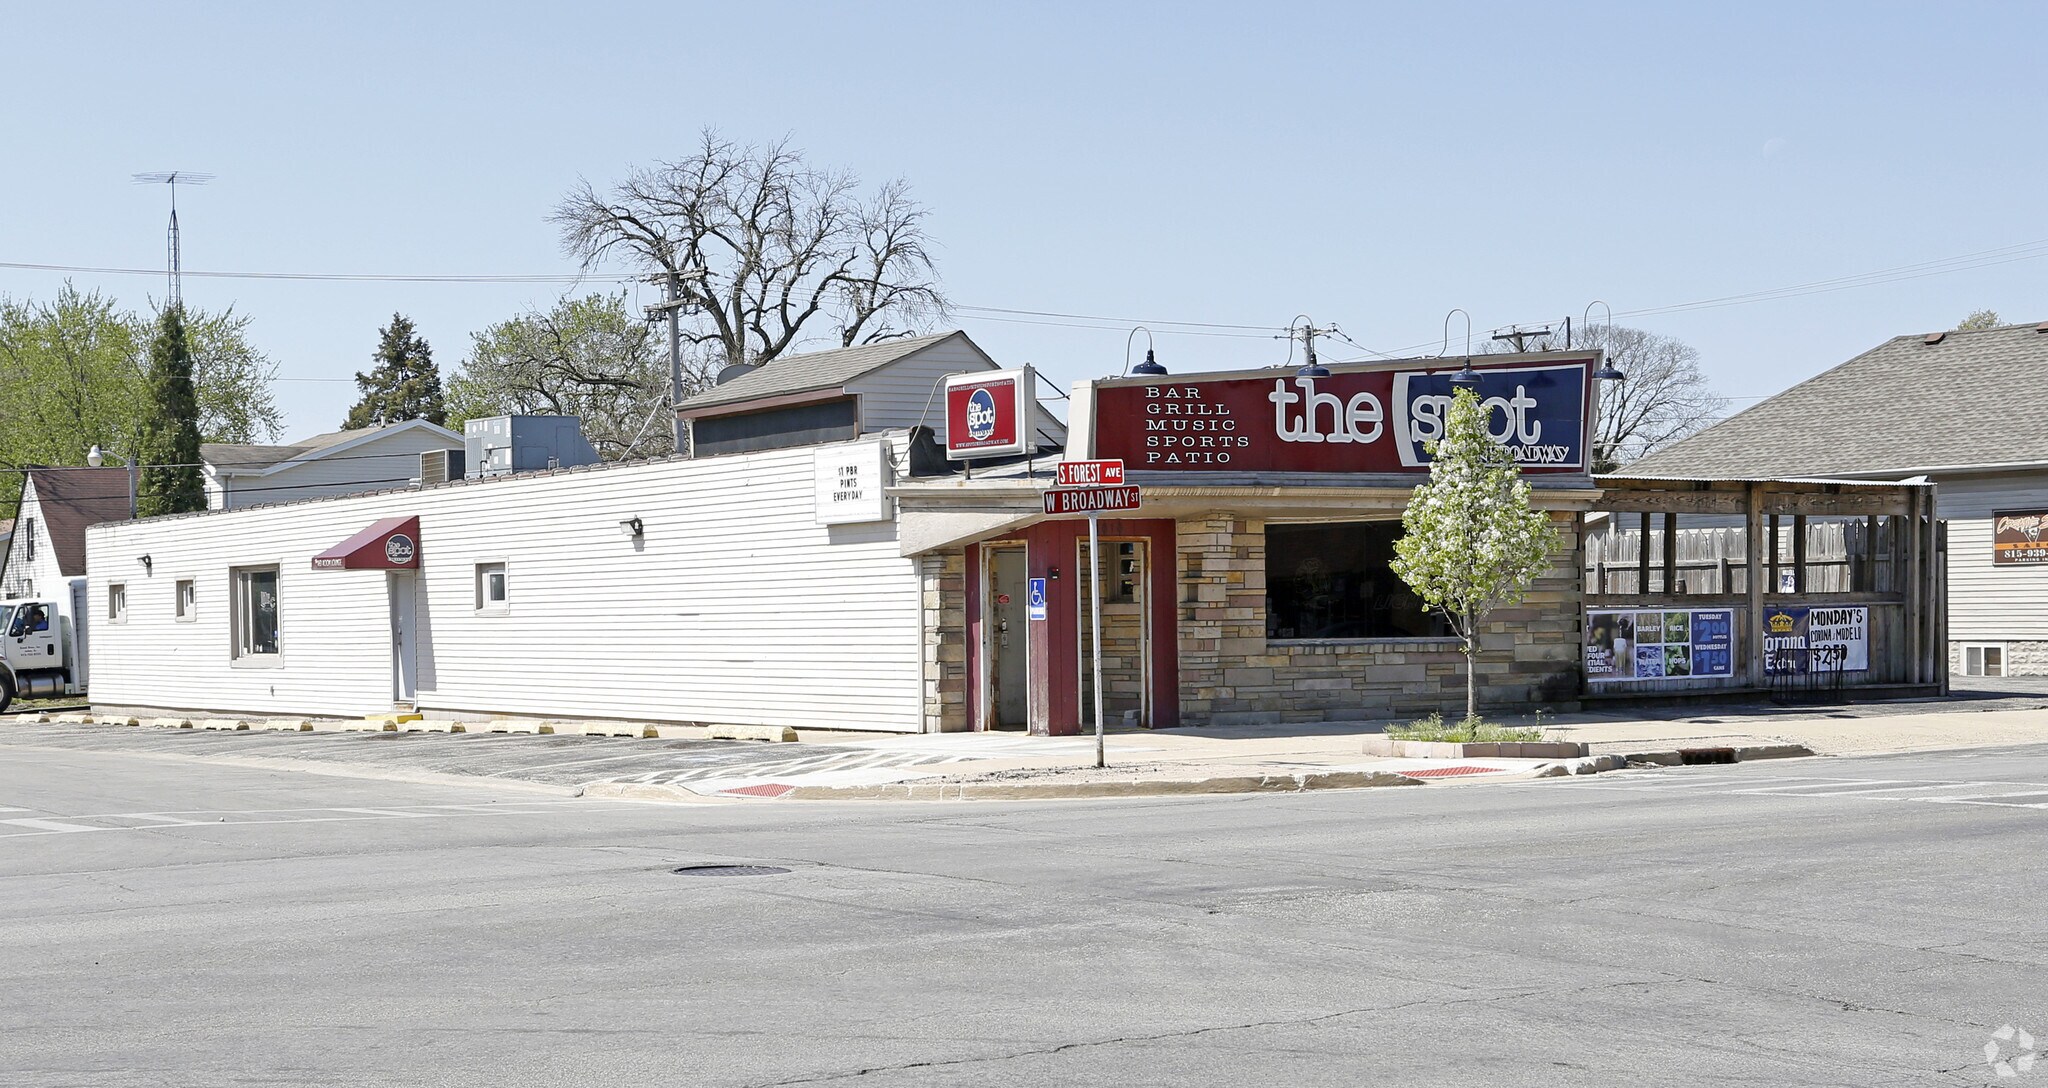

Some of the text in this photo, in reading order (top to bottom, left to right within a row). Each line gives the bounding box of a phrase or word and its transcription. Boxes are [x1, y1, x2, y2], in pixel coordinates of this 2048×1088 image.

[1145, 386, 1201, 398] BAR
[970, 402, 982, 412] the
[1146, 403, 1230, 415] GRILL
[1268, 378, 1541, 447] the sot
[969, 408, 993, 428] spot
[1145, 419, 1236, 432] MUSIC
[1146, 435, 1250, 448] SPORTS
[1146, 451, 1231, 464] PATIO
[846, 465, 858, 476] PBR
[1060, 464, 1121, 483] S FOREST AVE
[840, 478, 858, 488] PINTS
[833, 490, 863, 502] EVERYDAY
[1045, 488, 1139, 512] W BROADWAY ST
[388, 545, 412, 557] spot
[1810, 608, 1863, 626] MONDAY'S
[1669, 624, 1684, 632] RICE
[1694, 643, 1728, 651] WEDNESDAY
[1669, 657, 1687, 665] HOPS
